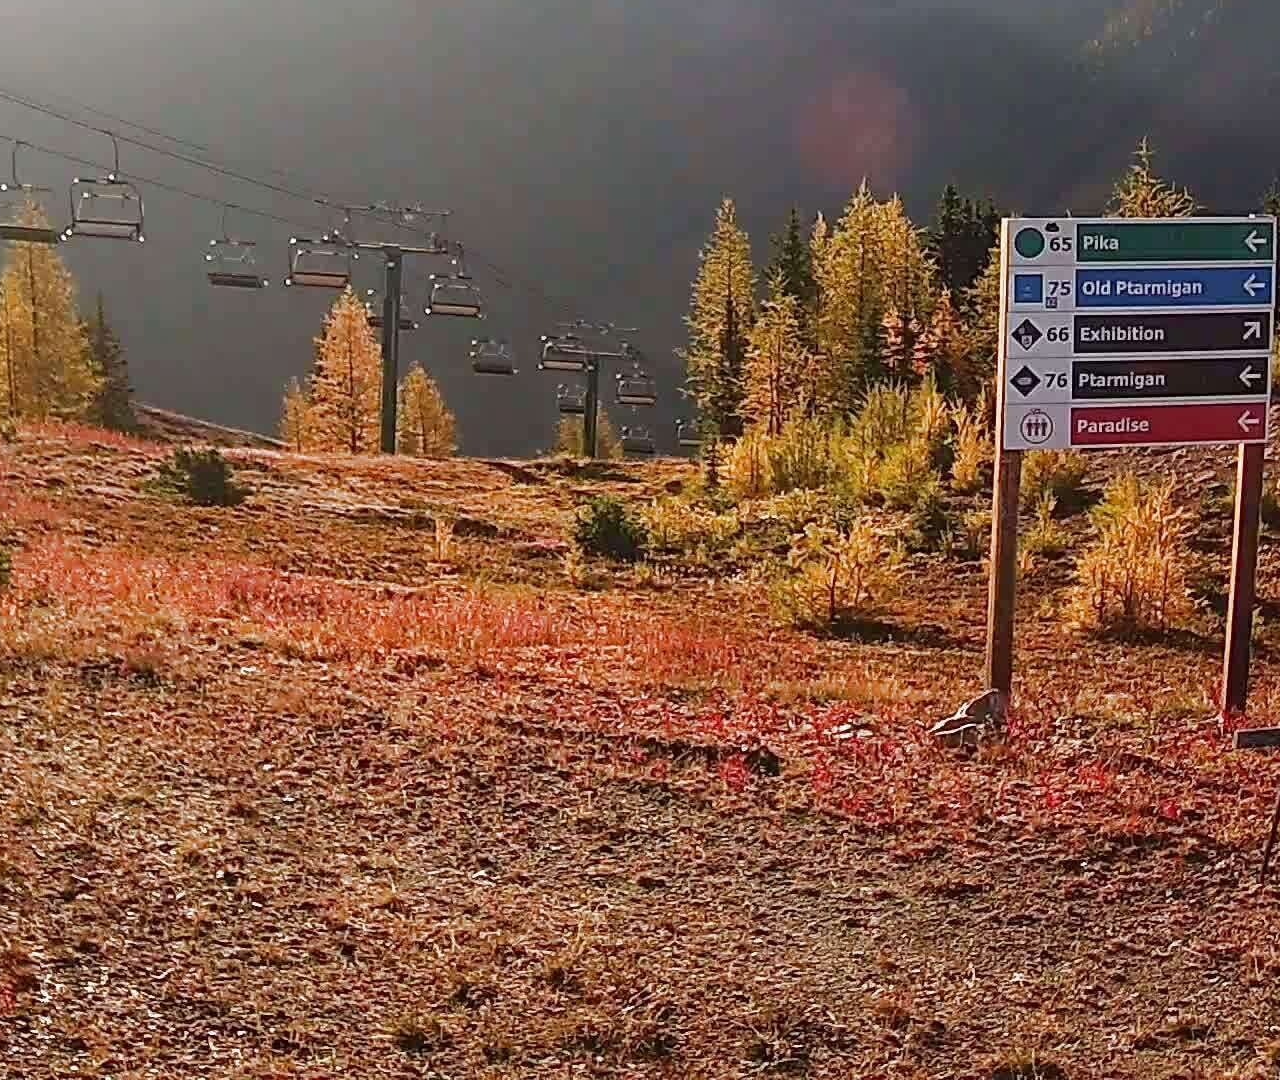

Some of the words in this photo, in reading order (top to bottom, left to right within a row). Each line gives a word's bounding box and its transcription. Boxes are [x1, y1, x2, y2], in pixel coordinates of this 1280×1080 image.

[1049, 236, 1073, 253] 65
[1083, 235, 1119, 250] Pika
[1048, 281, 1071, 296] 75
[1082, 279, 1111, 296] Old
[1116, 279, 1202, 299] Ptarmigan
[1046, 326, 1069, 342] 66
[1080, 326, 1165, 342] Exhibition
[1044, 372, 1068, 388] 76
[1078, 371, 1165, 391] Ptarmigan
[1077, 418, 1149, 433] Paradise
